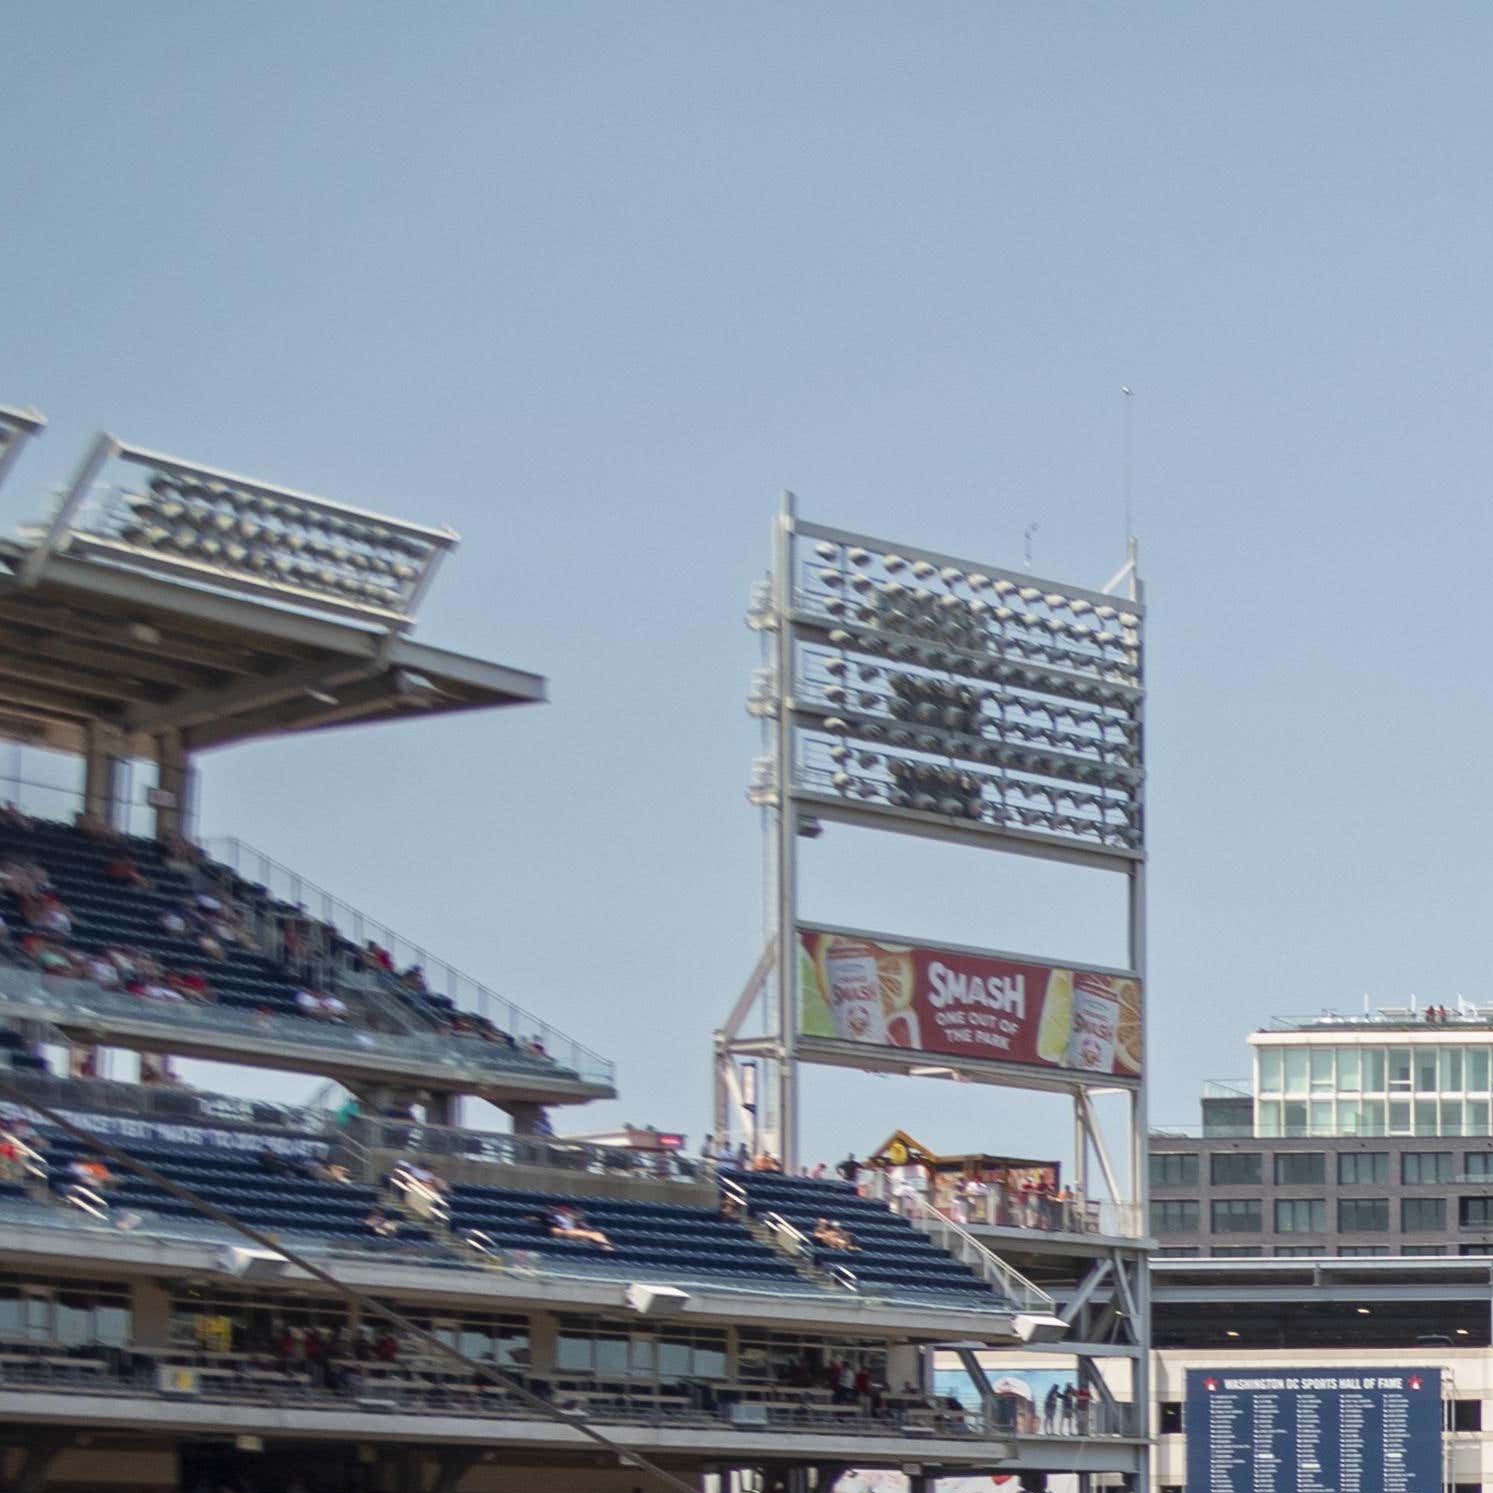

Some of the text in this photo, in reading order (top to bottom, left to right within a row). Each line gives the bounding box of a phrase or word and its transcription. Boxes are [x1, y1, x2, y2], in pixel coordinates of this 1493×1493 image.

[928, 961, 1025, 1019] SMASH
[935, 1011, 1020, 1035] ONE OUT OF
[944, 1028, 972, 1042] THE
[1286, 1379, 1300, 1390] DC
[1301, 1379, 1337, 1390] SPORTS
[1339, 1379, 1361, 1390] HALL
[1363, 1378, 1375, 1389] OF
[1378, 1378, 1402, 1389] FAME
